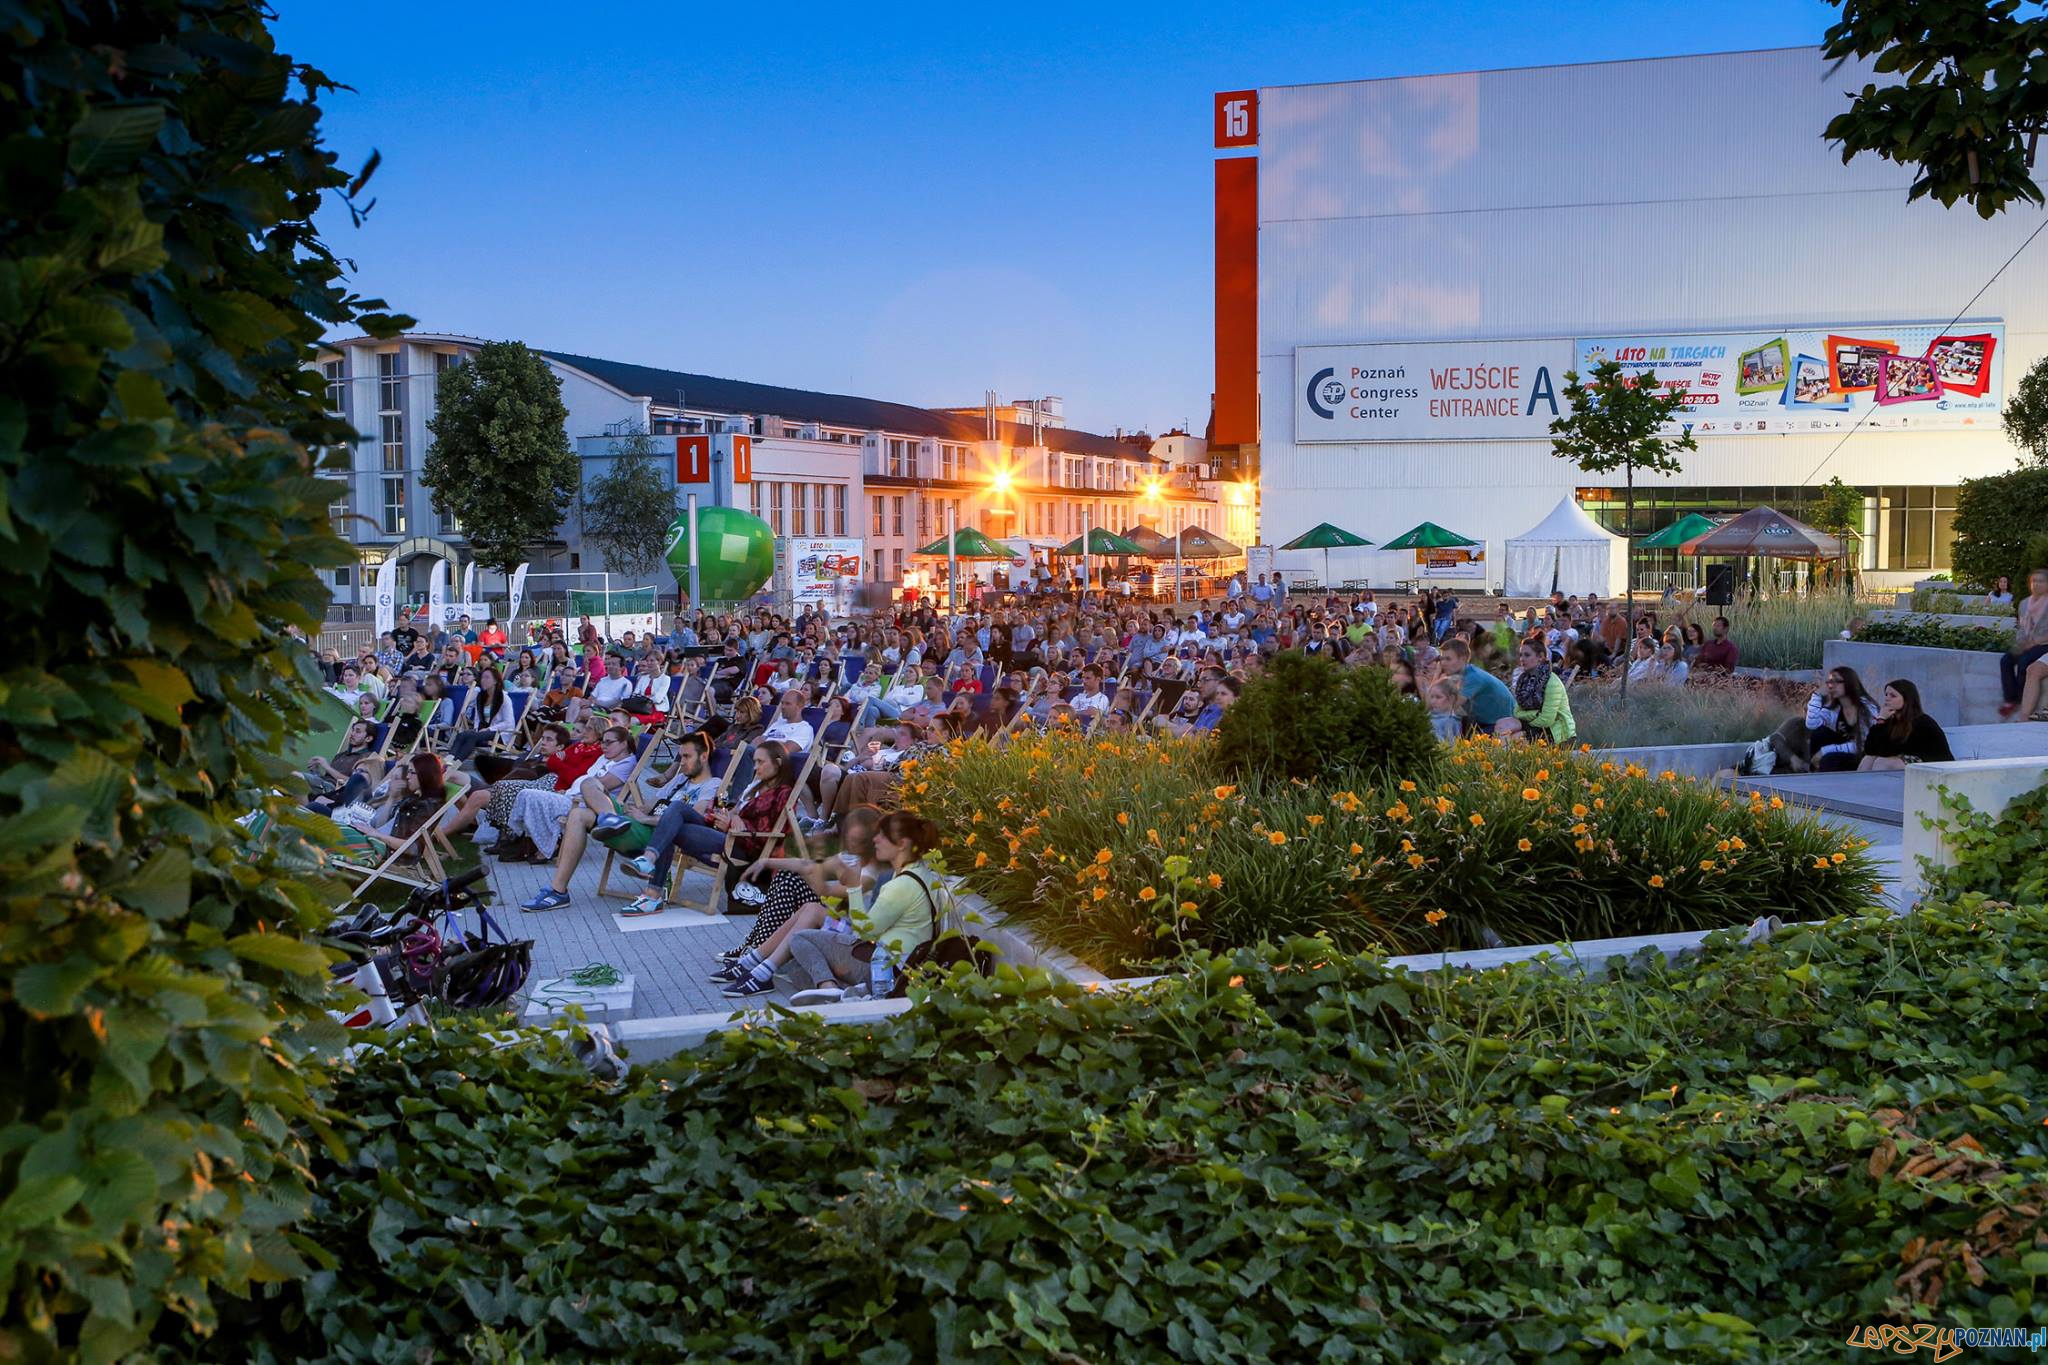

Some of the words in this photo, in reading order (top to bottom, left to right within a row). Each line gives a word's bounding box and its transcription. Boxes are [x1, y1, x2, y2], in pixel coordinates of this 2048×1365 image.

[1223, 99, 1248, 138] 15
[1615, 347, 1647, 361] LATO
[1649, 347, 1666, 360] NA
[1671, 346, 1726, 360] TARGACH
[1351, 365, 1405, 379] Poznań
[1429, 362, 1519, 390] WEJŚCIE
[1350, 387, 1418, 402] Congress
[1526, 366, 1559, 416] A
[1350, 406, 1399, 420] Center
[1429, 398, 1519, 418] ENTRANCE
[689, 444, 698, 475] 1
[740, 444, 746, 475] 1
